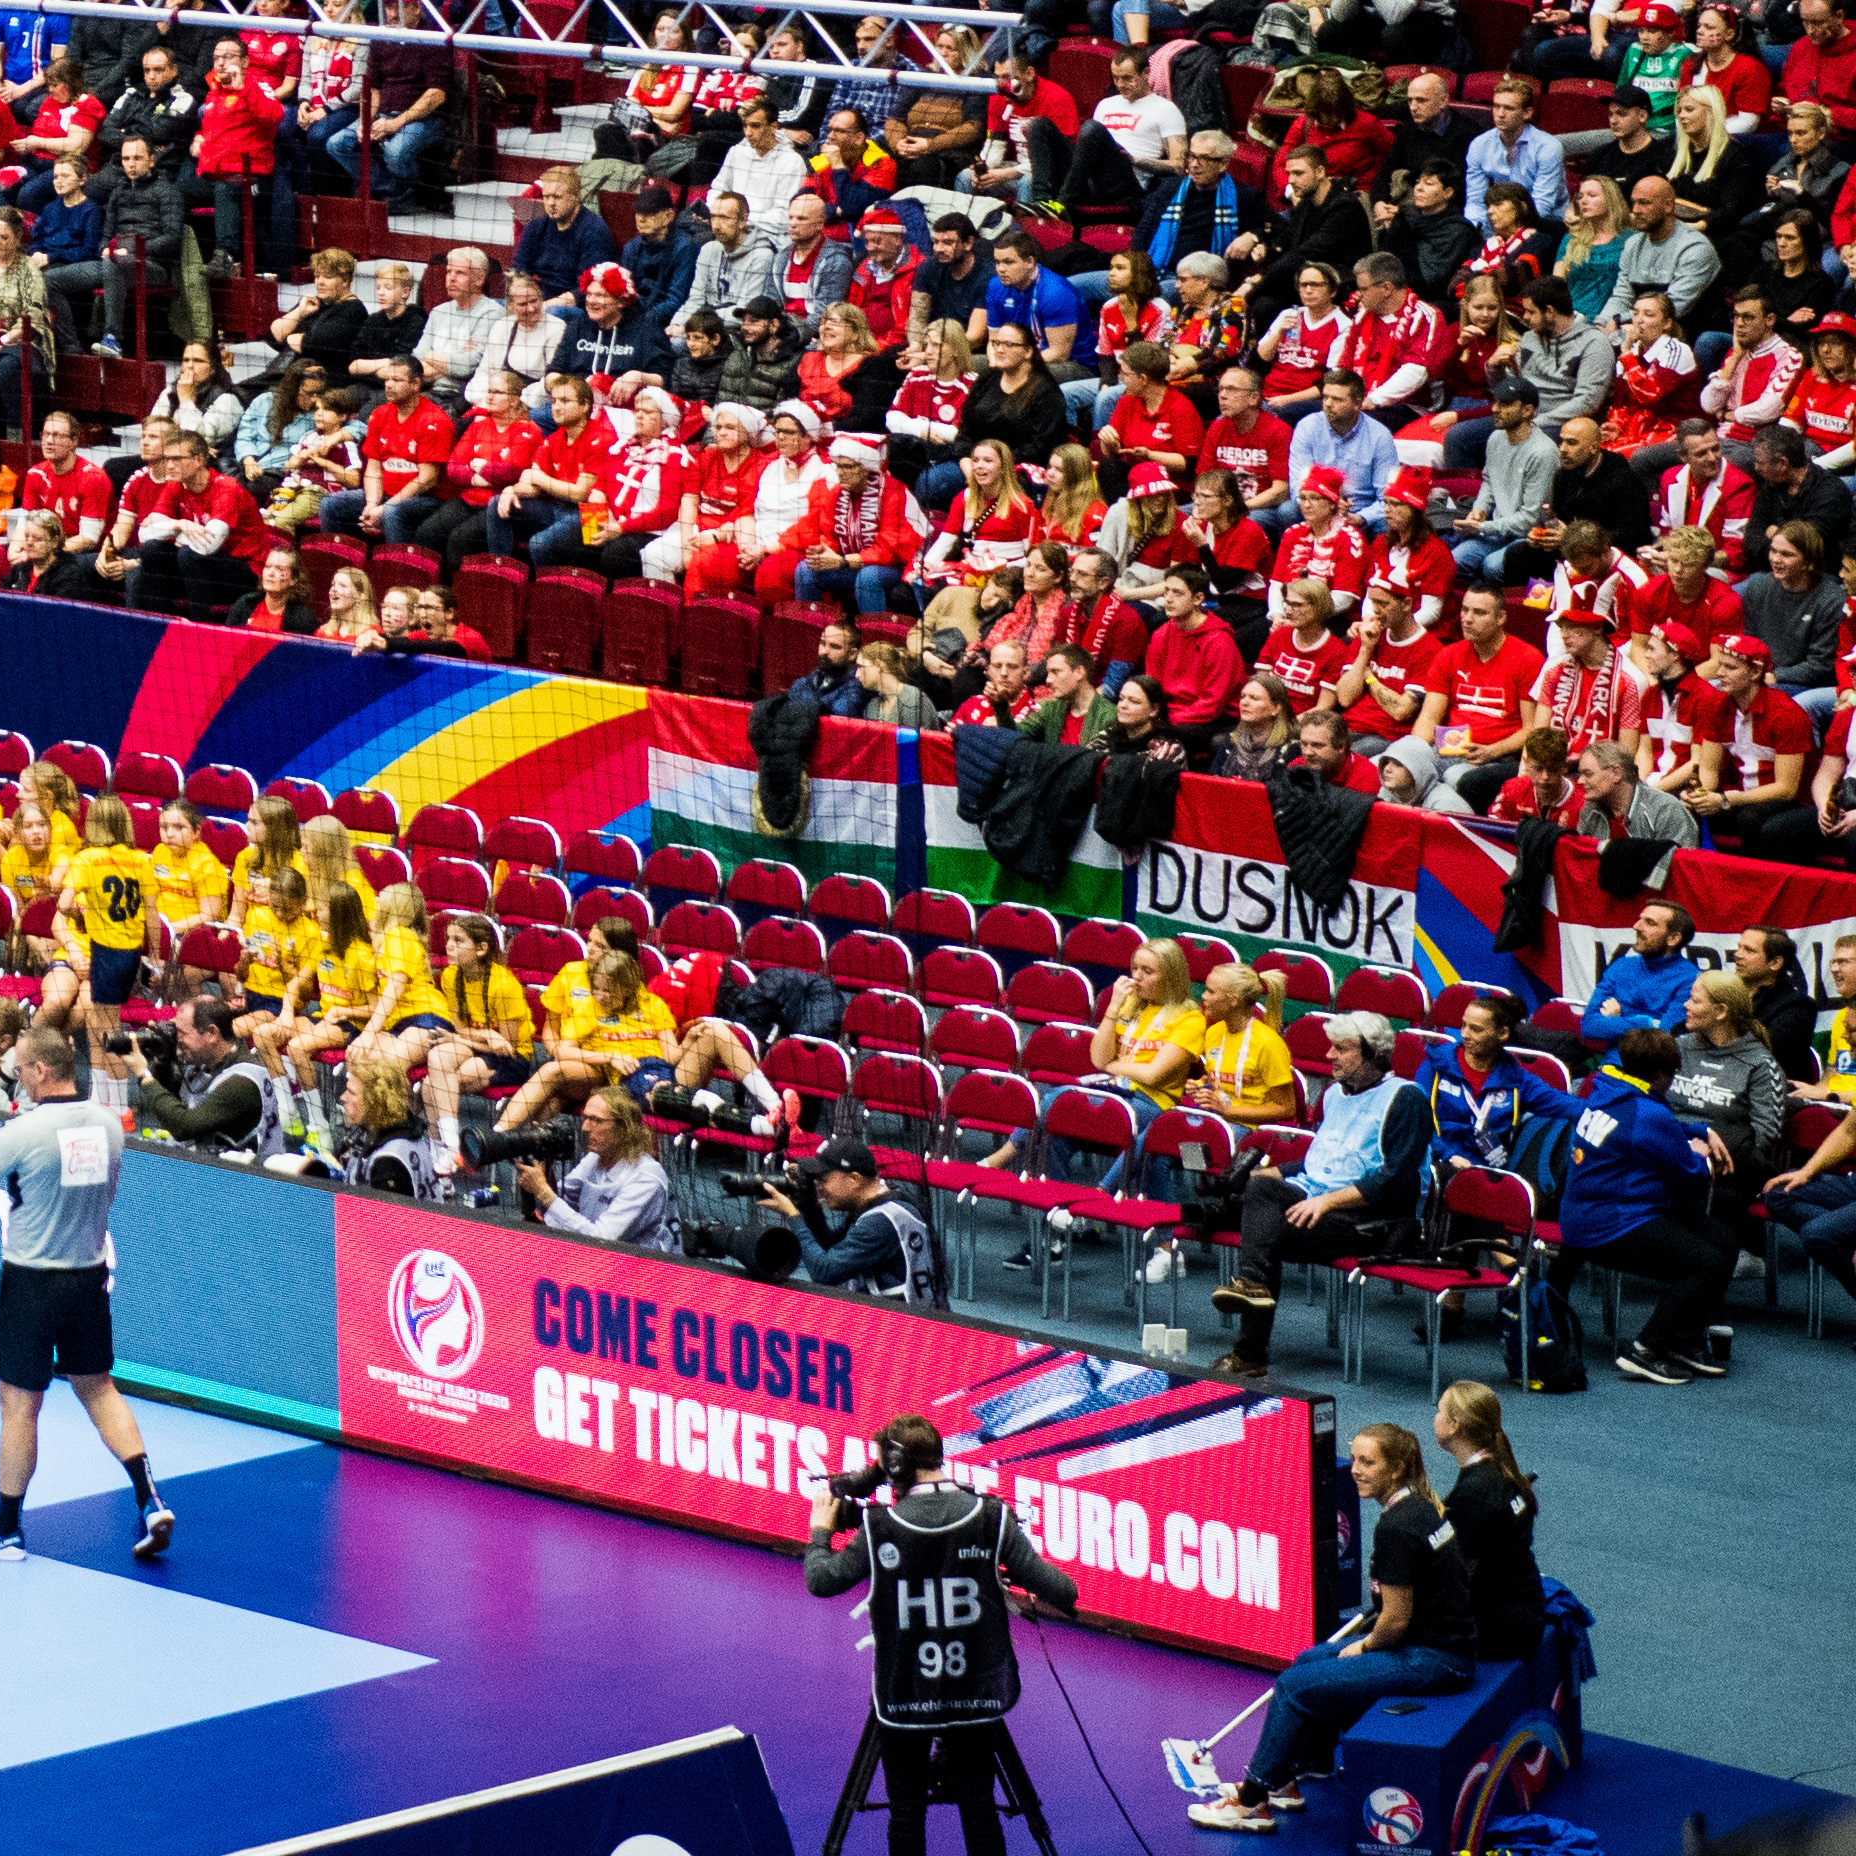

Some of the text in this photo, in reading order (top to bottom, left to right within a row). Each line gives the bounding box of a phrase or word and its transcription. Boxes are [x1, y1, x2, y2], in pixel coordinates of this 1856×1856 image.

[1216, 447, 1269, 463] HEROES
[534, 1280, 854, 1414] COME CLOSER
[534, 1366, 619, 1453] GET
[630, 1384, 829, 1500] TICKETS
[897, 1578, 981, 1629] HB
[918, 1641, 967, 1678] 98
